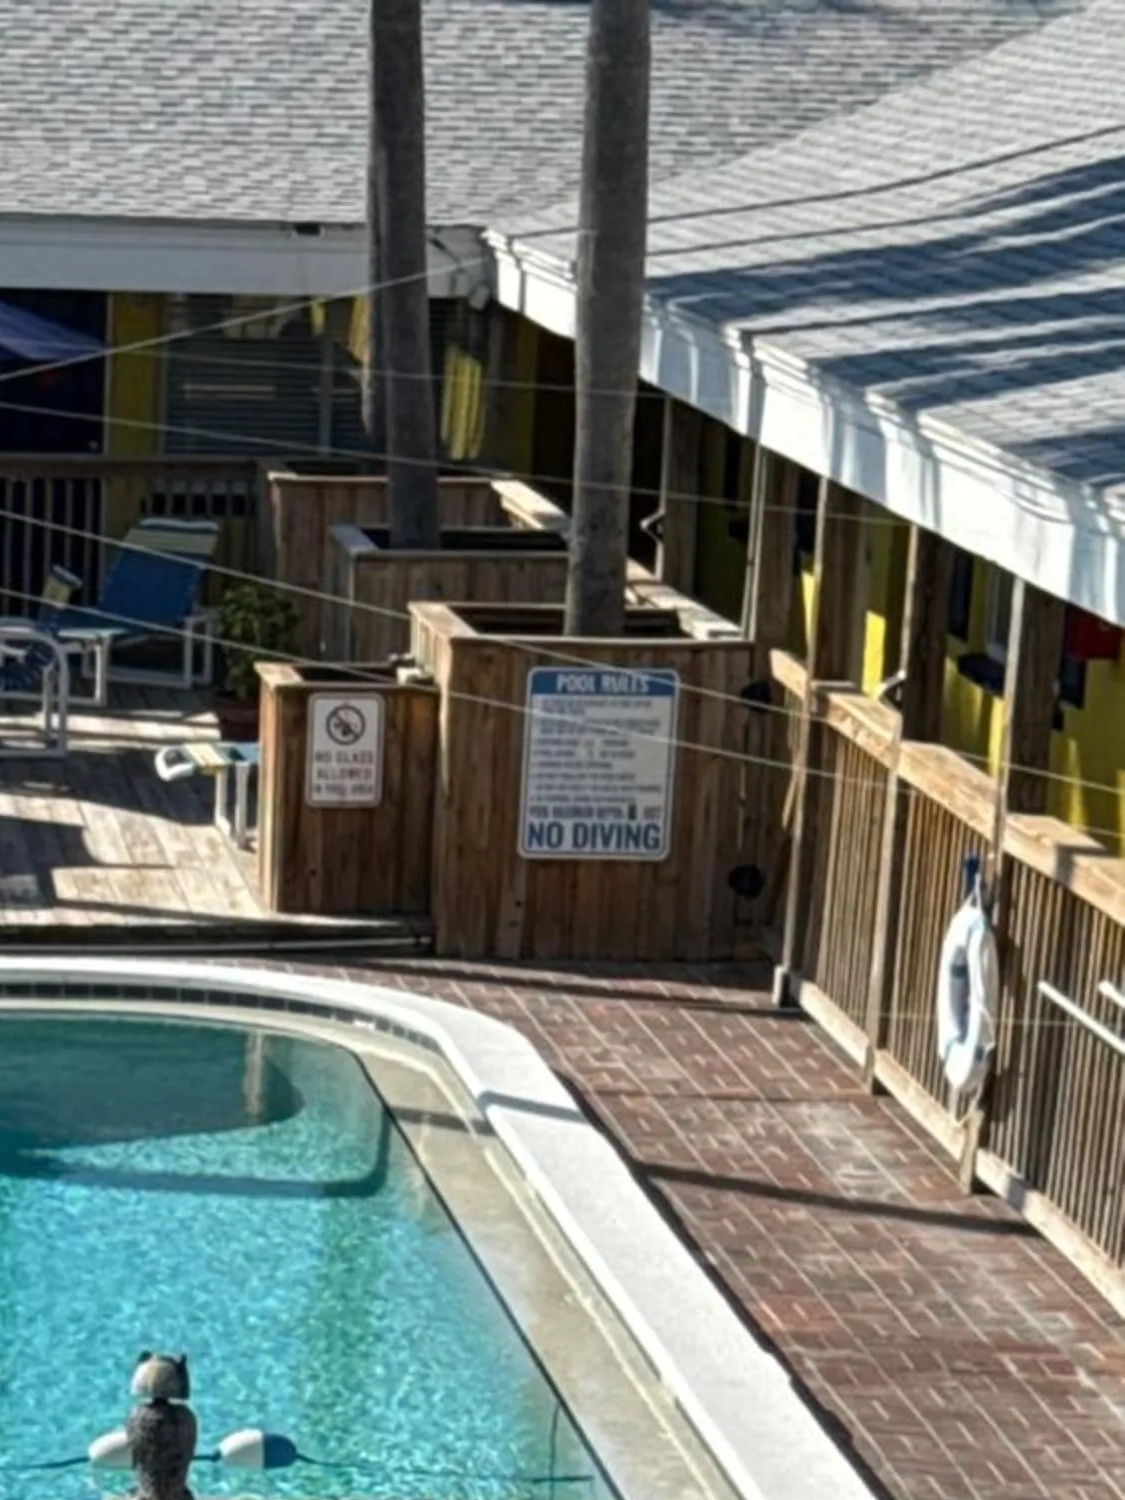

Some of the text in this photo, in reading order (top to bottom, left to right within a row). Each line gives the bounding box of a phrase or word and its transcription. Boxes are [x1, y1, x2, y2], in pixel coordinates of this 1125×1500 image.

[556, 674, 595, 692] POOL
[527, 821, 661, 850] NO DIVING
